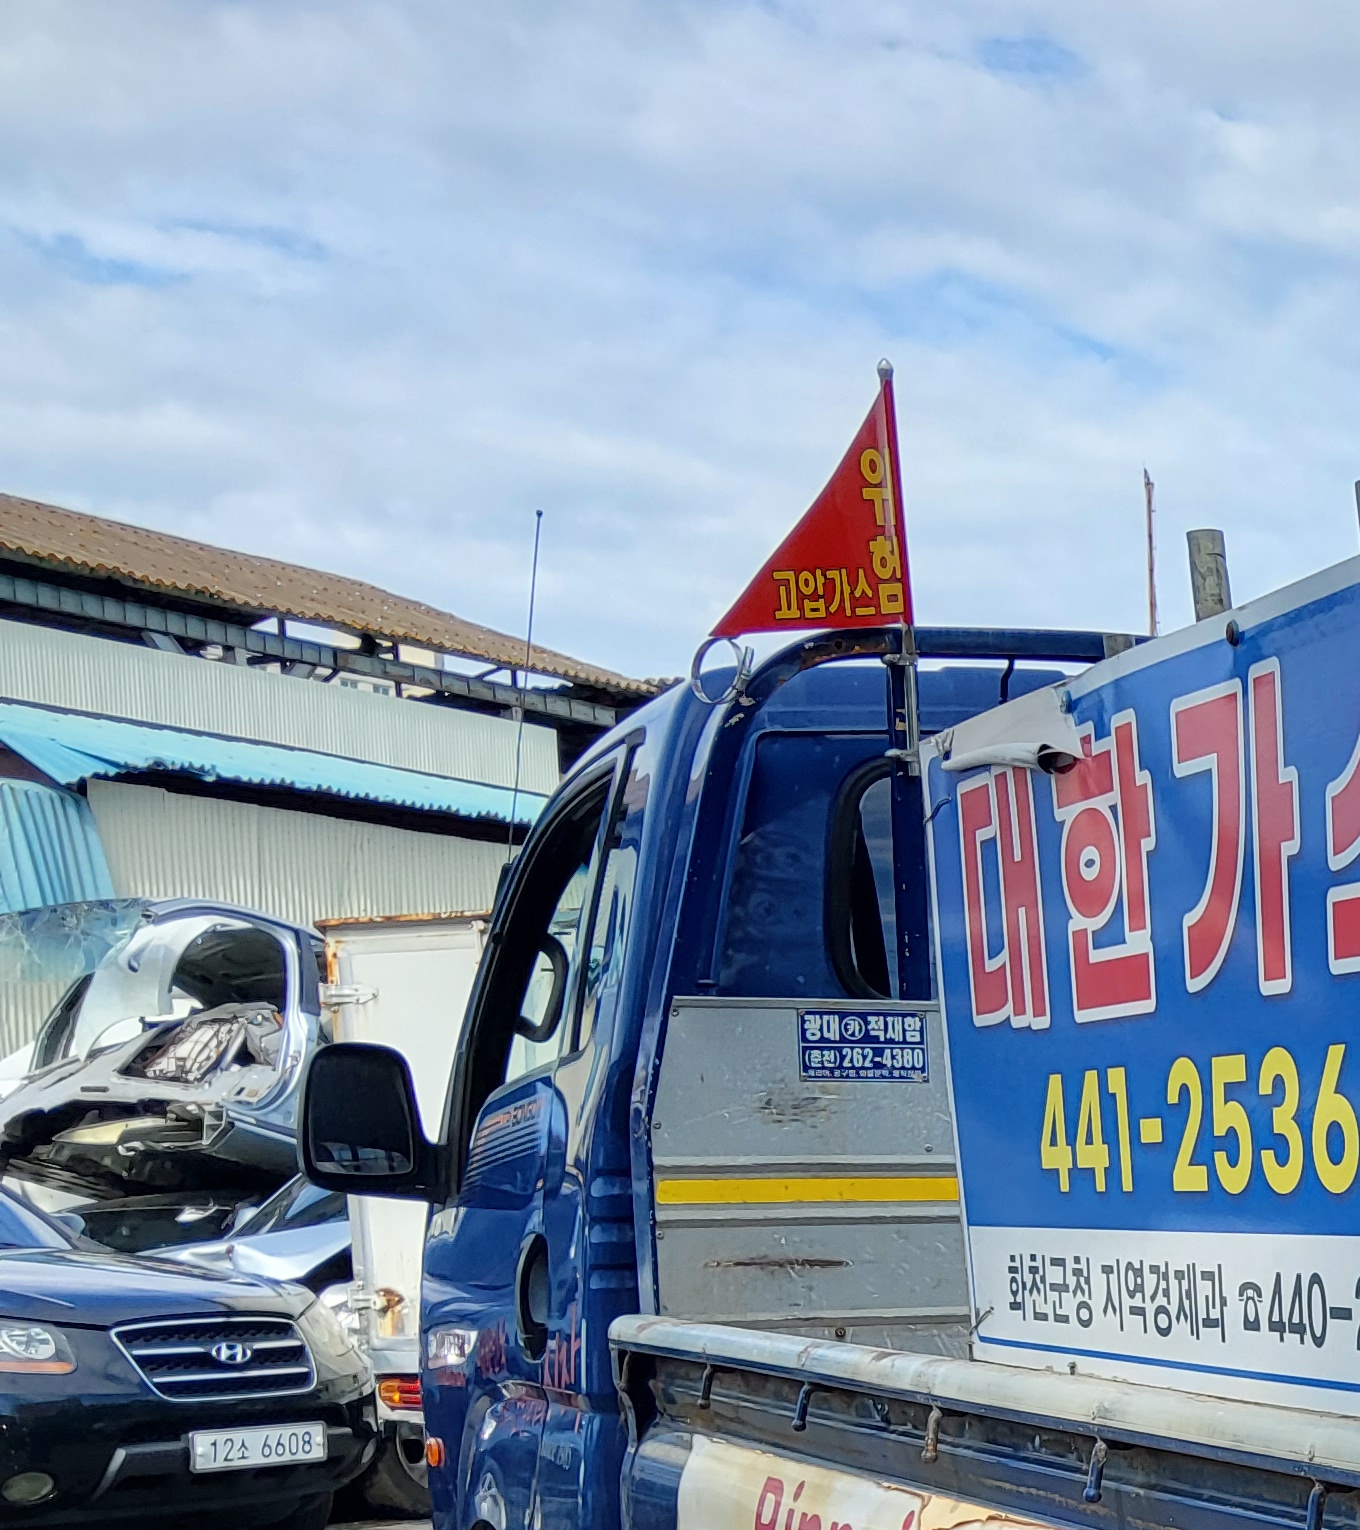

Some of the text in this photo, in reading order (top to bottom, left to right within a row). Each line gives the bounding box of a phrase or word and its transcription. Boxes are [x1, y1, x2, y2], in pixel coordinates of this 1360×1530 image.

[859, 447, 904, 614] 위험
[772, 567, 874, 620] 고압가스
[866, 1015, 922, 1043] 적재함
[842, 1047, 924, 1069] 262-4380
[1041, 1043, 1360, 1195] 441-2536
[1007, 1253, 1094, 1329] 화천군청
[1100, 1261, 1228, 1344] 지역경제과
[209, 1430, 313, 1464] 12소 6608
